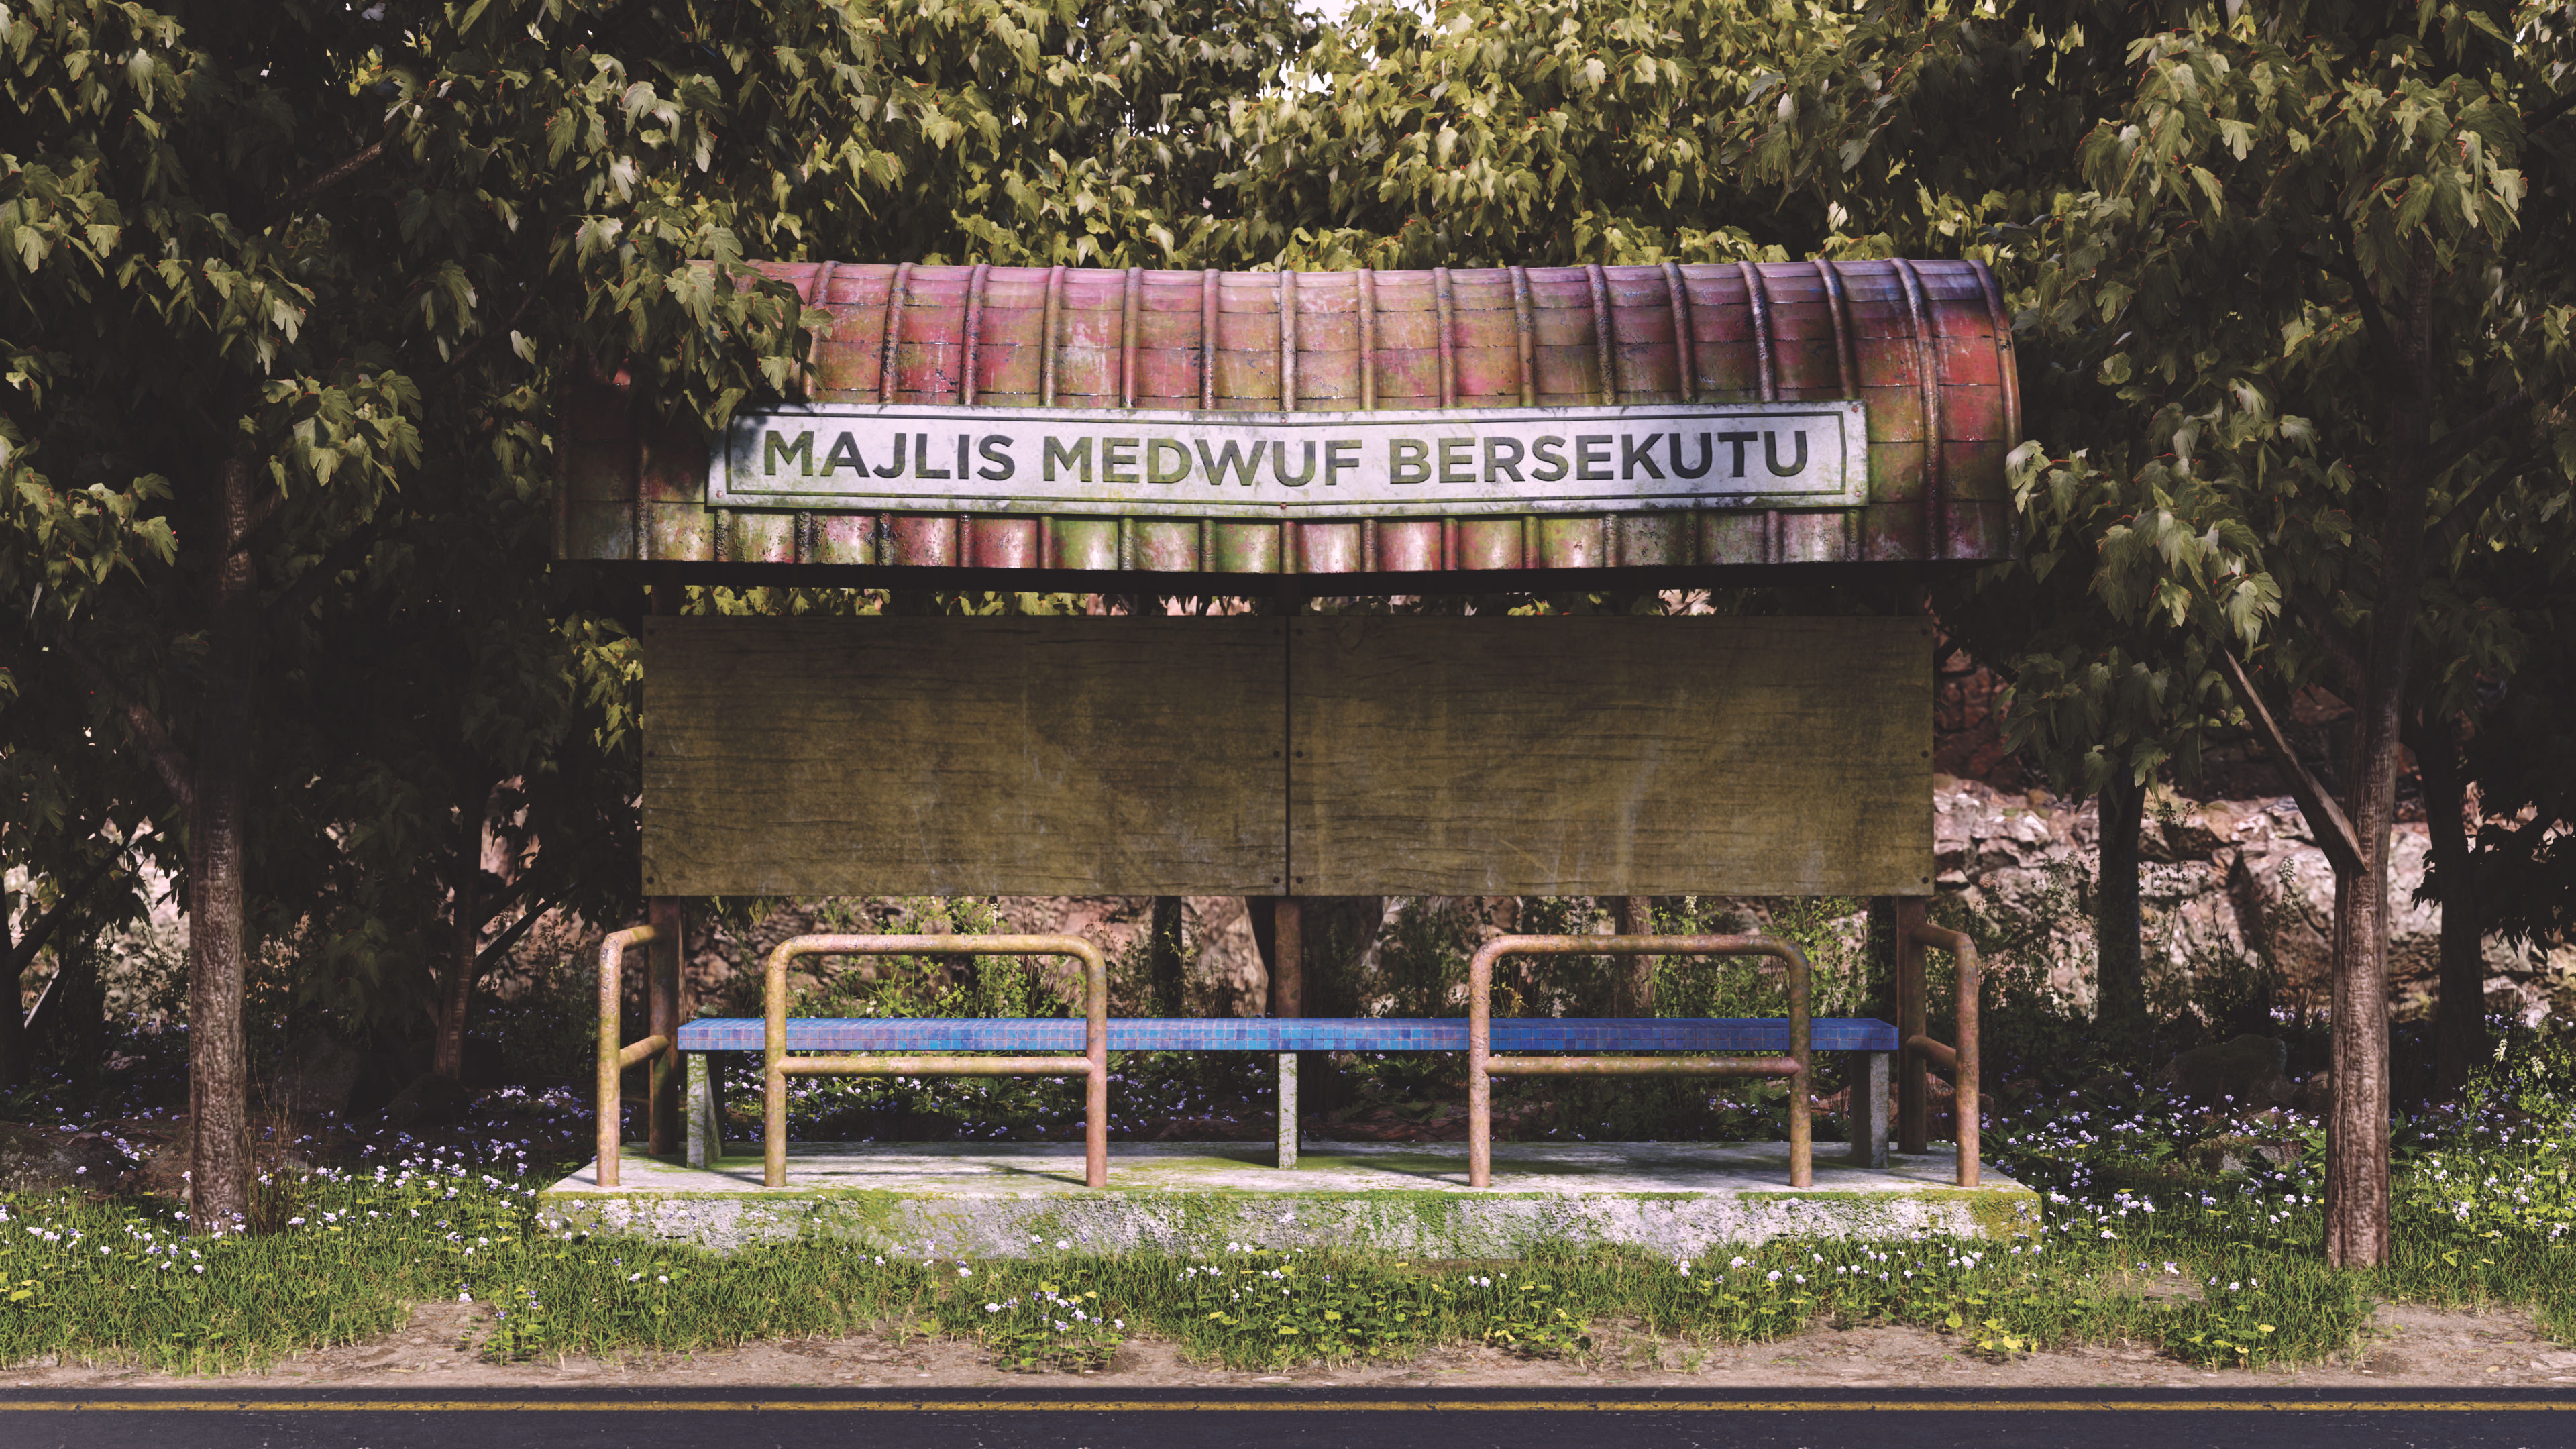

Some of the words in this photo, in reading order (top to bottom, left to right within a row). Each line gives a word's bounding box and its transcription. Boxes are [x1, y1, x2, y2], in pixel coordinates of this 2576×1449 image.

[763, 429, 1016, 481] MAJLIS
[1043, 435, 1362, 487] MEDWUF
[1389, 430, 1808, 484] BERSEKUTU
